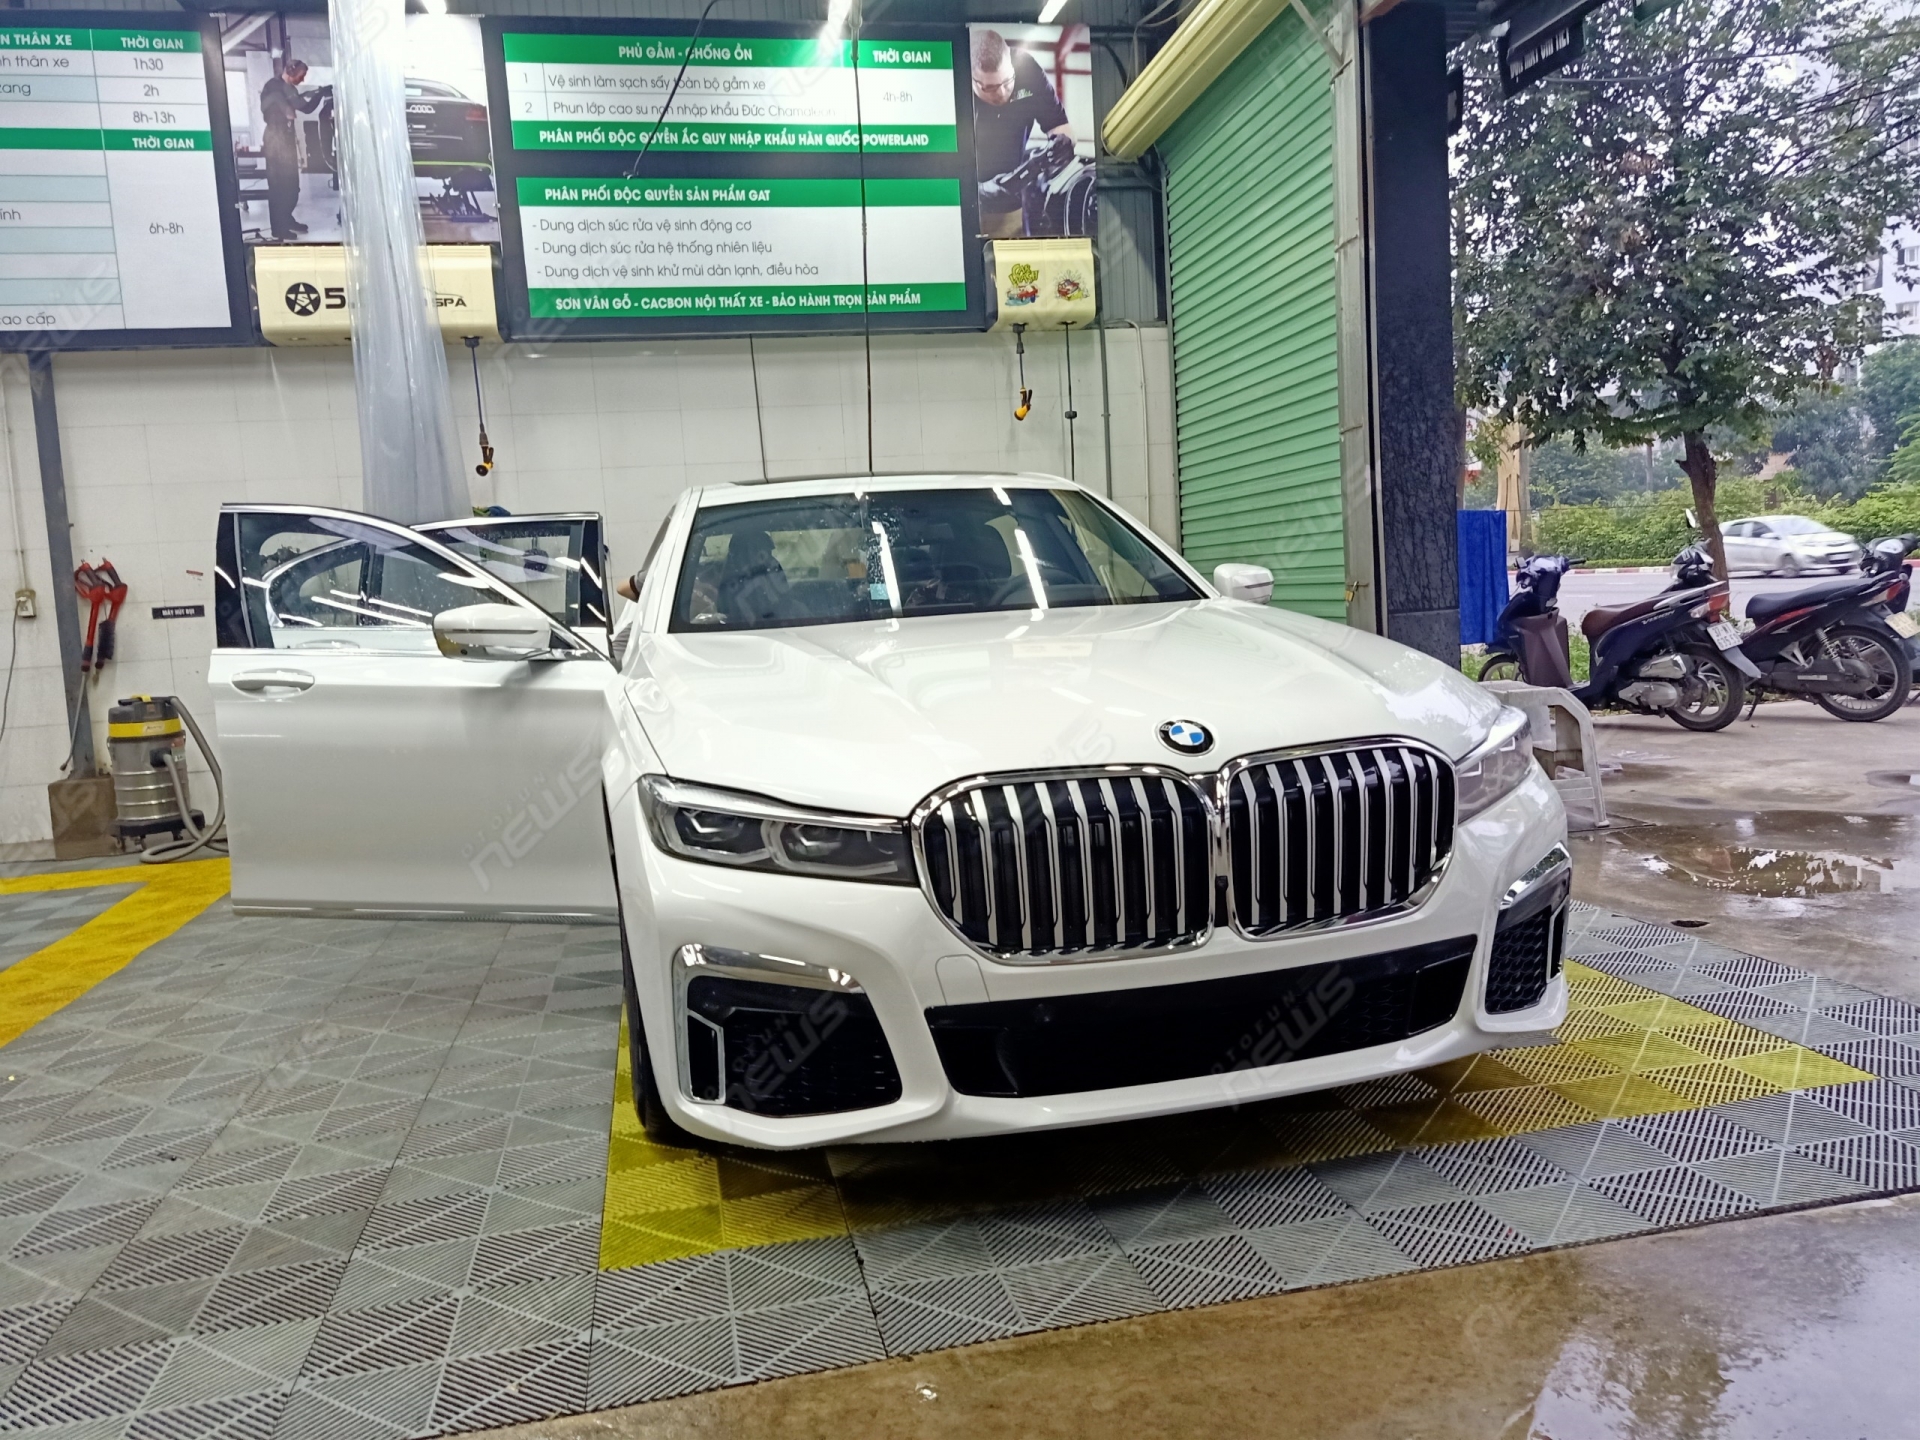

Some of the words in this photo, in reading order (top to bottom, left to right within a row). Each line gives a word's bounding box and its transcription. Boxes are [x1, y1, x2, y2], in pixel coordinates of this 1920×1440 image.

[14, 31, 51, 45] THÂN
[55, 34, 73, 46] XE
[121, 36, 150, 49] THỜI
[153, 38, 184, 50] GIAN
[618, 43, 643, 58] PHỦ
[647, 41, 676, 59] GẦM
[685, 43, 731, 60] CHỐNG
[872, 46, 900, 63] THỜI
[903, 51, 932, 63] GIAN
[16, 55, 49, 68] thân
[53, 58, 70, 68] xe
[133, 58, 164, 71] 1h30
[144, 85, 160, 97] 2h
[548, 75, 565, 88] Vệ
[569, 76, 591, 87] sinh
[594, 75, 617, 88] làm
[620, 76, 648, 90] sạch
[651, 75, 670, 92] sấy
[673, 76, 701, 89] toàn
[704, 76, 720, 91] bộ
[723, 76, 750, 92] gầm
[753, 80, 766, 90] xe
[883, 91, 913, 103] 4h-8h
[525, 102, 533, 113] 2
[553, 102, 584, 114] Phun
[586, 102, 605, 117] lớp
[609, 104, 633, 115] cao
[636, 105, 648, 115] su
[677, 104, 708, 117] nhập
[711, 101, 738, 117] khẩu
[742, 104, 765, 117] Đức
[133, 112, 176, 124] 8h-13h
[132, 136, 161, 149] THỜI
[164, 138, 194, 149] GIAN
[540, 128, 573, 143] PHÂN
[576, 128, 605, 143] PHỐI
[609, 129, 636, 147] ĐỘC
[639, 127, 679, 144] QUYỀN
[682, 127, 699, 144] ẮC
[702, 132, 726, 145] QUY
[730, 130, 761, 148] NHẬP
[765, 128, 796, 145] KHẨU
[799, 131, 823, 146] HÀN
[826, 129, 860, 146] QUỐC
[862, 134, 929, 146] POWERLAND
[545, 186, 578, 201] PHÂN
[582, 185, 610, 201] PHỐI
[614, 187, 641, 204] ĐỘC
[645, 184, 683, 202] QUYỀN
[686, 186, 710, 202] SẢN
[713, 184, 746, 202] PHẨM
[749, 190, 771, 201] GAT
[150, 223, 184, 234] 6h-8h
[540, 219, 574, 234] Dung
[578, 218, 605, 234] dịch
[608, 219, 629, 231] súc
[633, 218, 653, 231] rửa
[656, 220, 672, 233] vệ
[674, 219, 697, 231] sinh
[700, 219, 733, 234] động
[736, 220, 752, 231] cơ
[543, 242, 576, 256] Dung
[580, 242, 607, 256] dịch
[610, 242, 631, 254] súc
[635, 240, 655, 254] rửa
[658, 242, 674, 256] hệ
[677, 240, 713, 256] thống
[716, 242, 749, 253] nhiên
[752, 242, 773, 255] liệu
[545, 266, 579, 280] Dung
[582, 265, 609, 280] dịch
[612, 266, 628, 279] vệ
[631, 266, 654, 277] sinh
[658, 264, 680, 277] khử
[682, 265, 704, 276] mùi
[707, 265, 731, 276] dàn
[734, 264, 763, 278] lạnh,
[767, 262, 793, 276] điều
[795, 264, 819, 276] hòa
[556, 297, 581, 310] SƠN
[584, 295, 609, 309] VÂN
[612, 293, 632, 309] GỖ
[641, 298, 692, 309] CACBON
[695, 295, 716, 311] NỘI
[719, 292, 746, 308] THẤT
[750, 297, 763, 308] XE
[772, 292, 796, 307] BẢO
[799, 294, 831, 307] HÀNH
[833, 294, 863, 309] TRỌN
[867, 290, 887, 306] SẢN
[890, 288, 921, 305] PHẨM
[0, 316, 22, 325] ao
[26, 312, 56, 326] cấp
